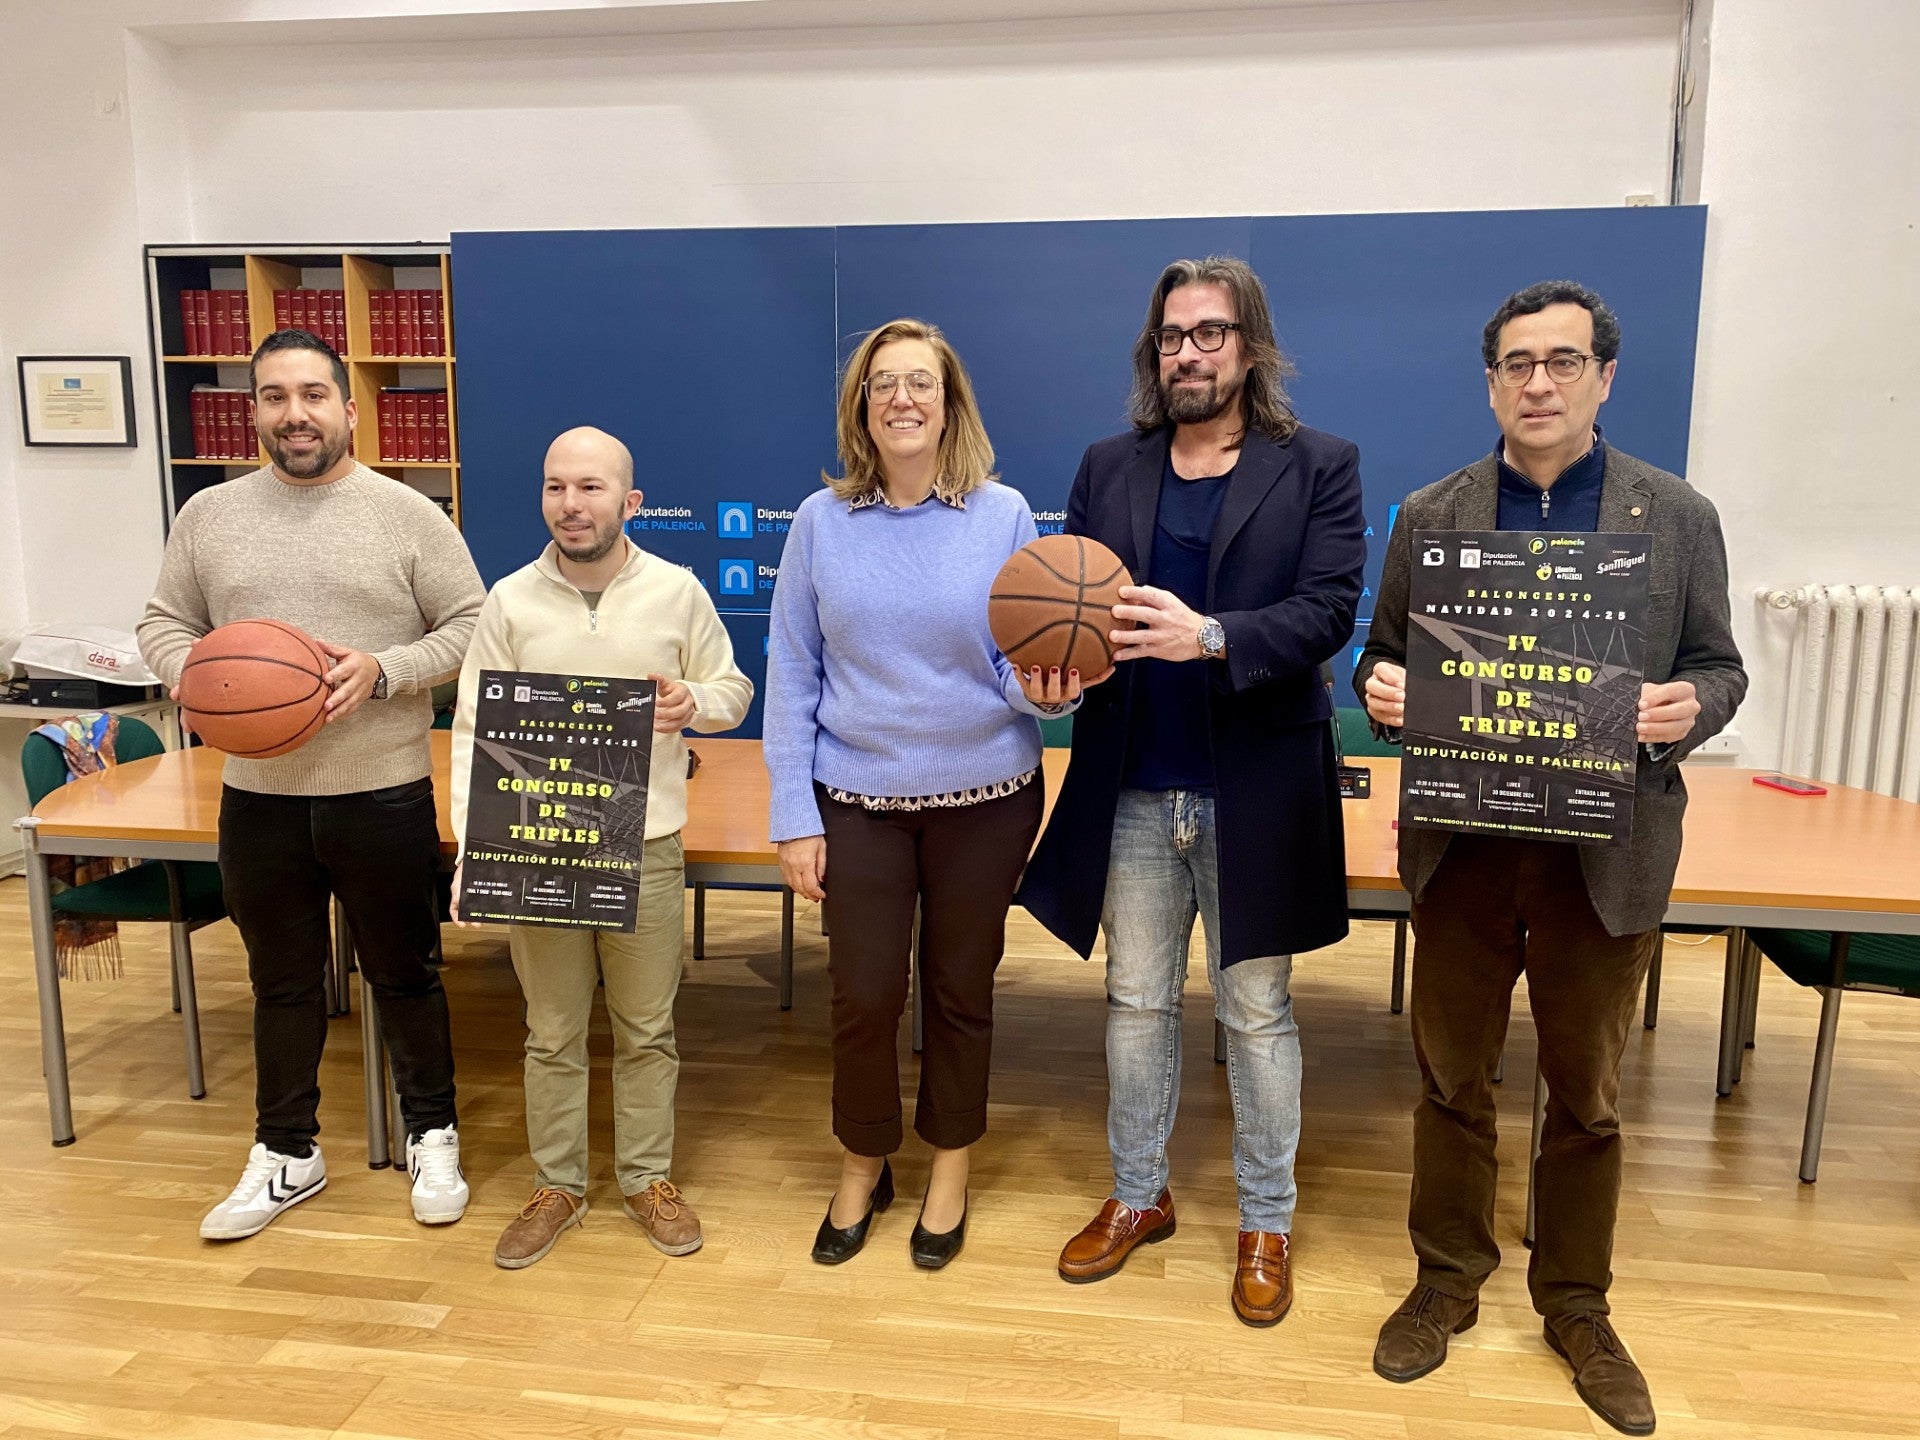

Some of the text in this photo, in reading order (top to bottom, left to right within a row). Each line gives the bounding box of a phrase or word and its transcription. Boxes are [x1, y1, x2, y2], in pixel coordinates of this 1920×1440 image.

[757, 508, 797, 521] Diputa
[633, 521, 706, 531] DE PALENCIA
[757, 523, 773, 532] DE
[1482, 552, 1517, 560] Diputación
[759, 580, 773, 589] DE
[1467, 589, 1592, 602] BALONCESTO
[1426, 604, 1626, 621] NAVIDAD 2024-25
[1507, 635, 1537, 652] IV
[88, 652, 116, 667] dara
[1441, 660, 1593, 684] CONCURSO
[1496, 690, 1532, 708] DE
[519, 719, 614, 732] BALONCESTO
[1459, 716, 1577, 740] TRIPLES
[487, 731, 638, 747] NAVIDAD 2024-25
[548, 757, 572, 771] IV
[1406, 746, 1630, 772] "DIPUTACIÓN DE PALENCIA"
[497, 778, 613, 798] CONCURSO
[539, 803, 567, 818] DE
[509, 825, 600, 844] TRIPLES
[466, 851, 637, 870] "DIPUTACIÓN DE PALENCIA"
